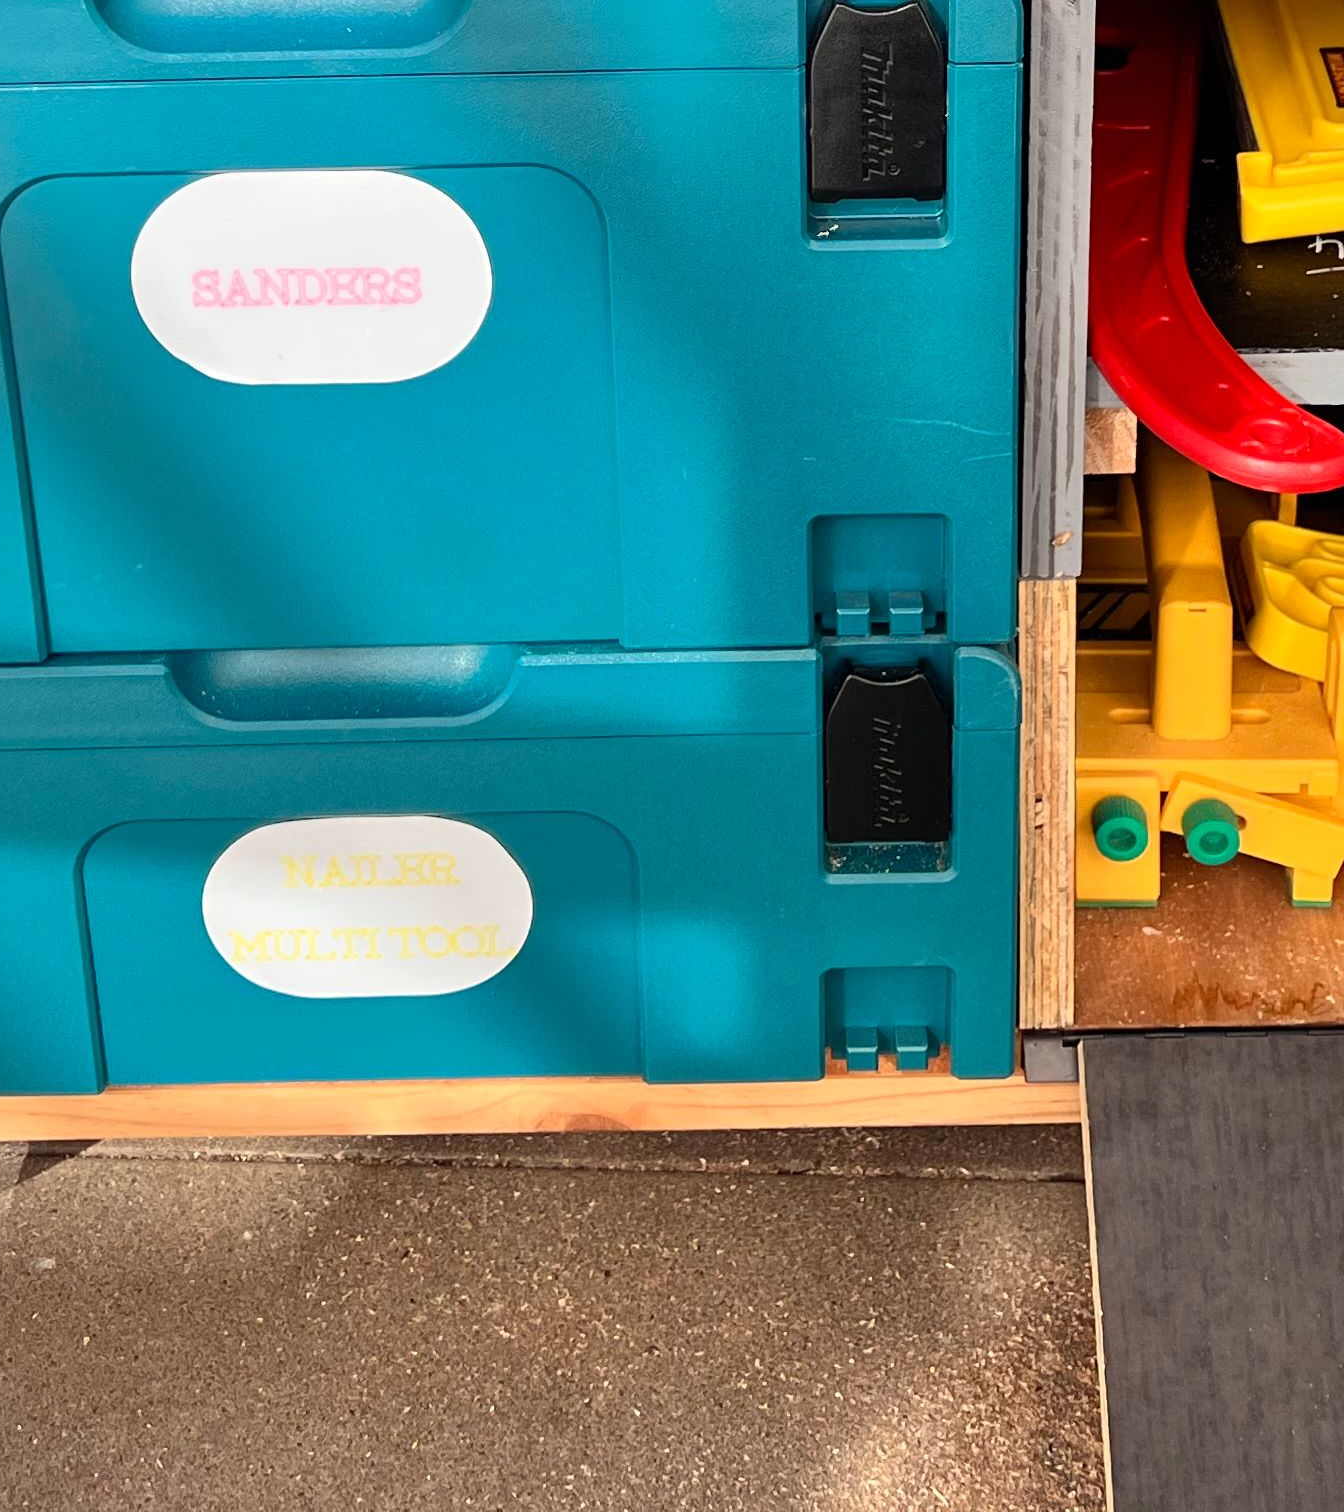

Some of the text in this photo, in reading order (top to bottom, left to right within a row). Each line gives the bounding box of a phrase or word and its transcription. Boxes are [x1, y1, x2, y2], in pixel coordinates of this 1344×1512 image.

[192, 267, 423, 308] SANDERS
[280, 851, 461, 889] NAILER
[228, 924, 517, 964] MULTI TOOL
